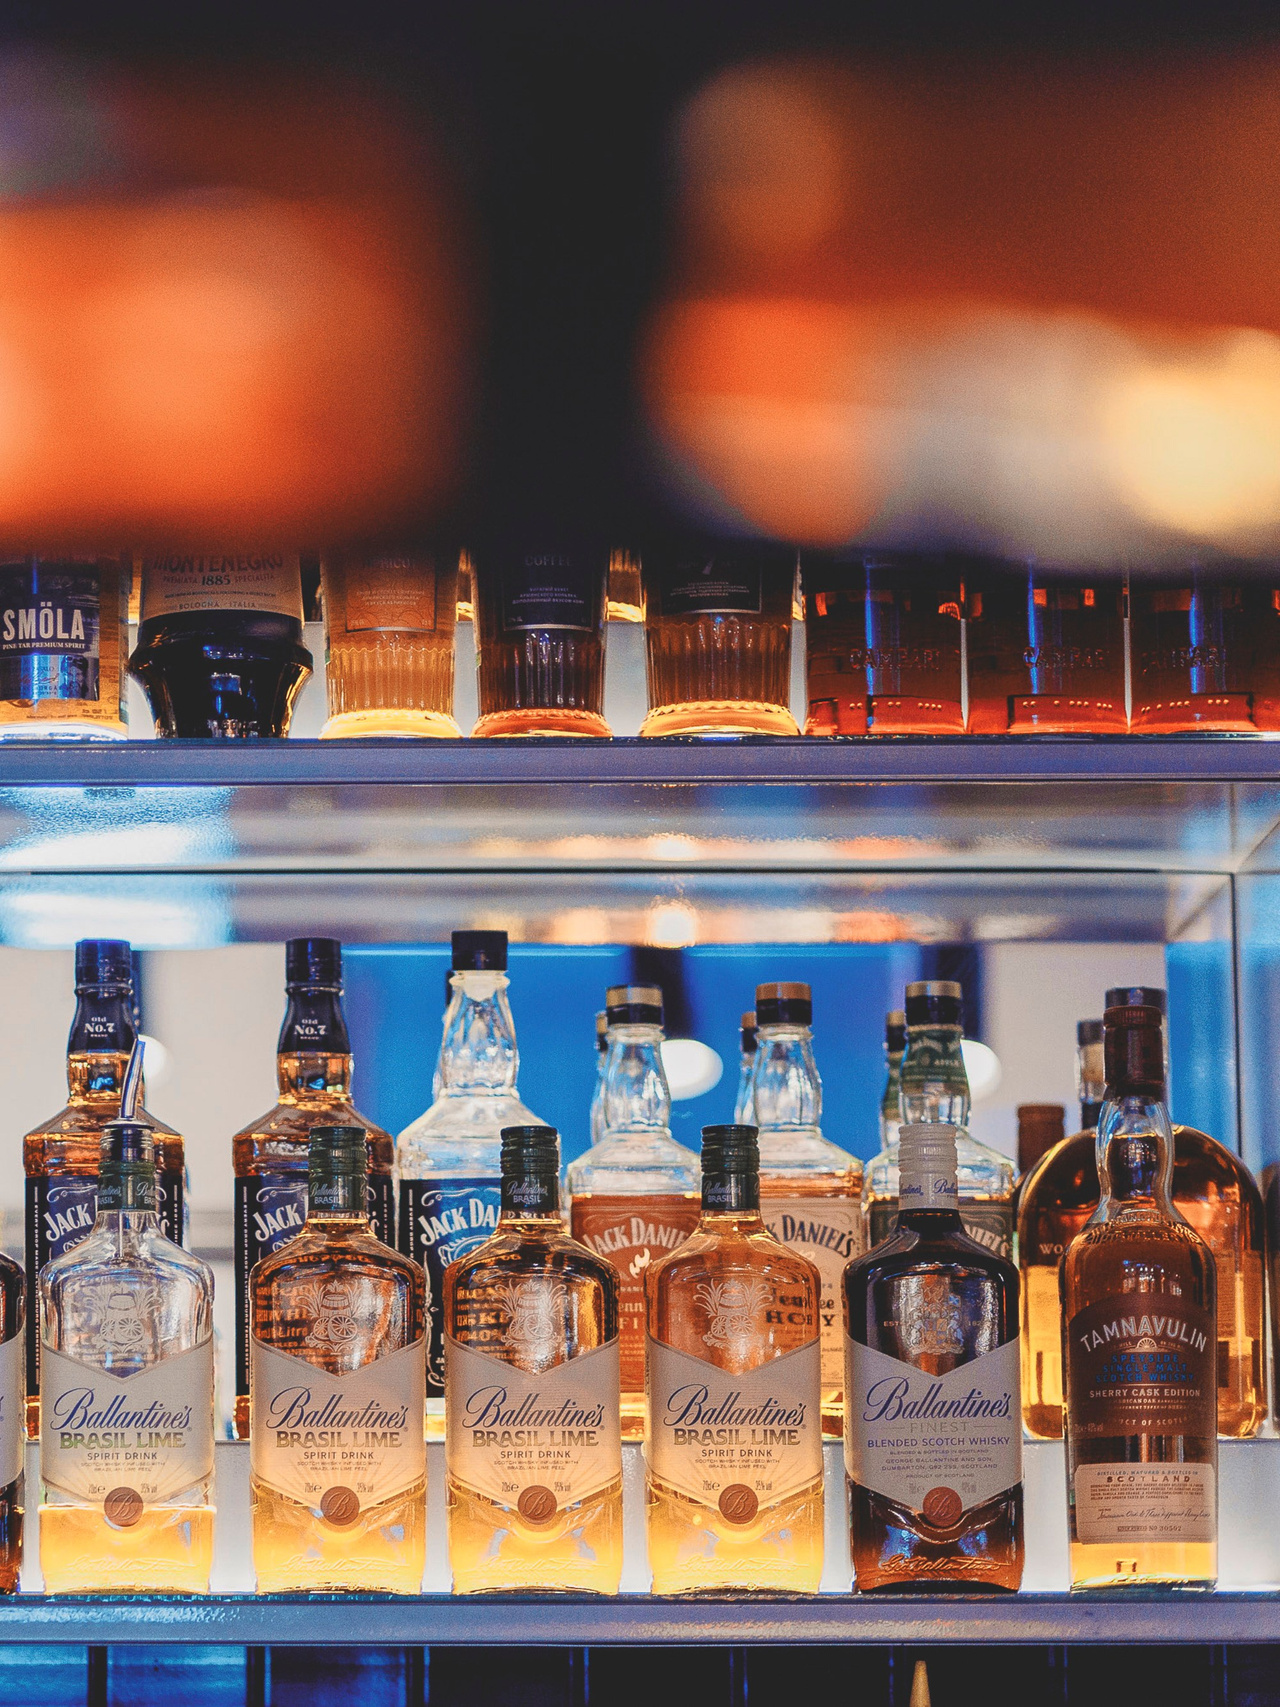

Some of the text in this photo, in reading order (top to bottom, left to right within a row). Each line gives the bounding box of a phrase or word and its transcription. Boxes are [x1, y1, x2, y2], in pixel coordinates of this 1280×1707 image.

[201, 574, 231, 586] 1885
[178, 601, 220, 610] BOLOGNA
[2, 601, 85, 641] SMÖLA
[84, 1022, 115, 1034] No.7
[294, 1024, 326, 1036] No.7
[506, 1181, 548, 1197] Ballantine's
[512, 1195, 542, 1204] BRASIL
[43, 1202, 93, 1242] JACK
[252, 1203, 303, 1241] JACK
[417, 1206, 469, 1247] JACK
[582, 1225, 627, 1255] JACK
[781, 1214, 855, 1259] DANIEL'S
[1080, 1315, 1207, 1353] TAMNAVULIN
[1111, 1353, 1179, 1364] SPEYSIDE
[1101, 1363, 1187, 1373] SINGLE MALT
[1095, 1373, 1194, 1383] SCOTCH WHISKY
[862, 1376, 1012, 1422] Ballantine's
[1089, 1388, 1201, 1398] SHERRY CASK EDITION
[49, 1387, 193, 1430] Ballantine's
[266, 1386, 409, 1429] Ballantine's
[462, 1385, 605, 1428] Ballantine's
[663, 1383, 807, 1427] Ballantine's
[909, 1421, 970, 1434] FINEST
[59, 1431, 187, 1450] BRASIL LIME
[276, 1430, 403, 1449] BRASIL LIME
[472, 1429, 600, 1448] BRASIL LIME
[673, 1428, 801, 1447] BRASIL LIME
[867, 1437, 1011, 1449] BLENDED SCOTCH WHISKY
[87, 1452, 158, 1460] SPIRIT DRINK
[303, 1451, 374, 1459] SPIRIT DRINK
[500, 1450, 571, 1459] SPIRIT DRINK
[701, 1449, 773, 1457] SPIRIT DRINK
[1106, 1475, 1191, 1484] SCOTLAND
